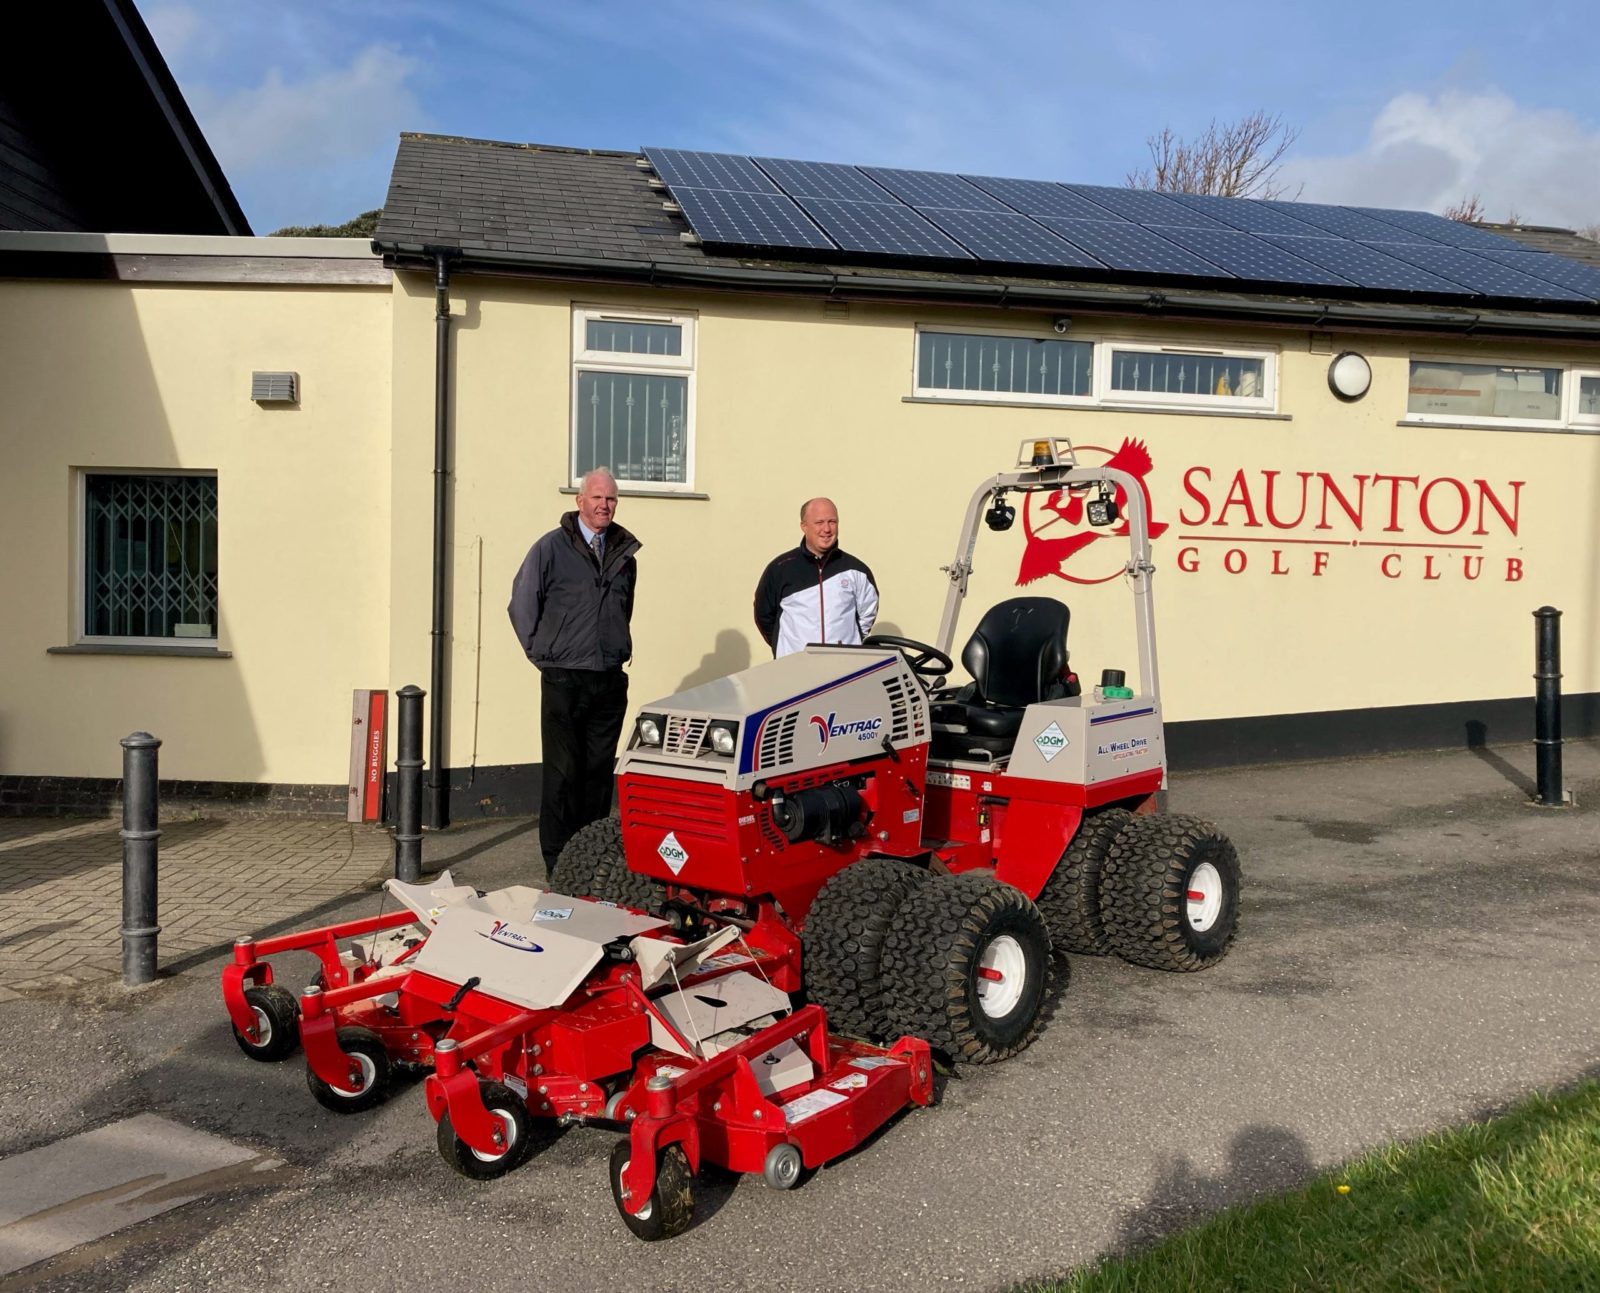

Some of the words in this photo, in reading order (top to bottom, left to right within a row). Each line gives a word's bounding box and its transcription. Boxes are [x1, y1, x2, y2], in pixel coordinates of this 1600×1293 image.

[1179, 466, 1526, 537] SAUNTON
[1177, 547, 1330, 576] GOLF
[1381, 553, 1524, 582] CLUB
[810, 712, 882, 756] VENTRAC
[1043, 735, 1064, 746] DGM
[371, 730, 380, 767] BUGGIES
[1098, 745, 1109, 755] ALL
[1110, 742, 1130, 752] WHEEL
[1131, 738, 1147, 748] DRIVE
[371, 768, 377, 782] NO
[664, 846, 684, 859] DGM
[490, 920, 527, 942] VENTRAC
